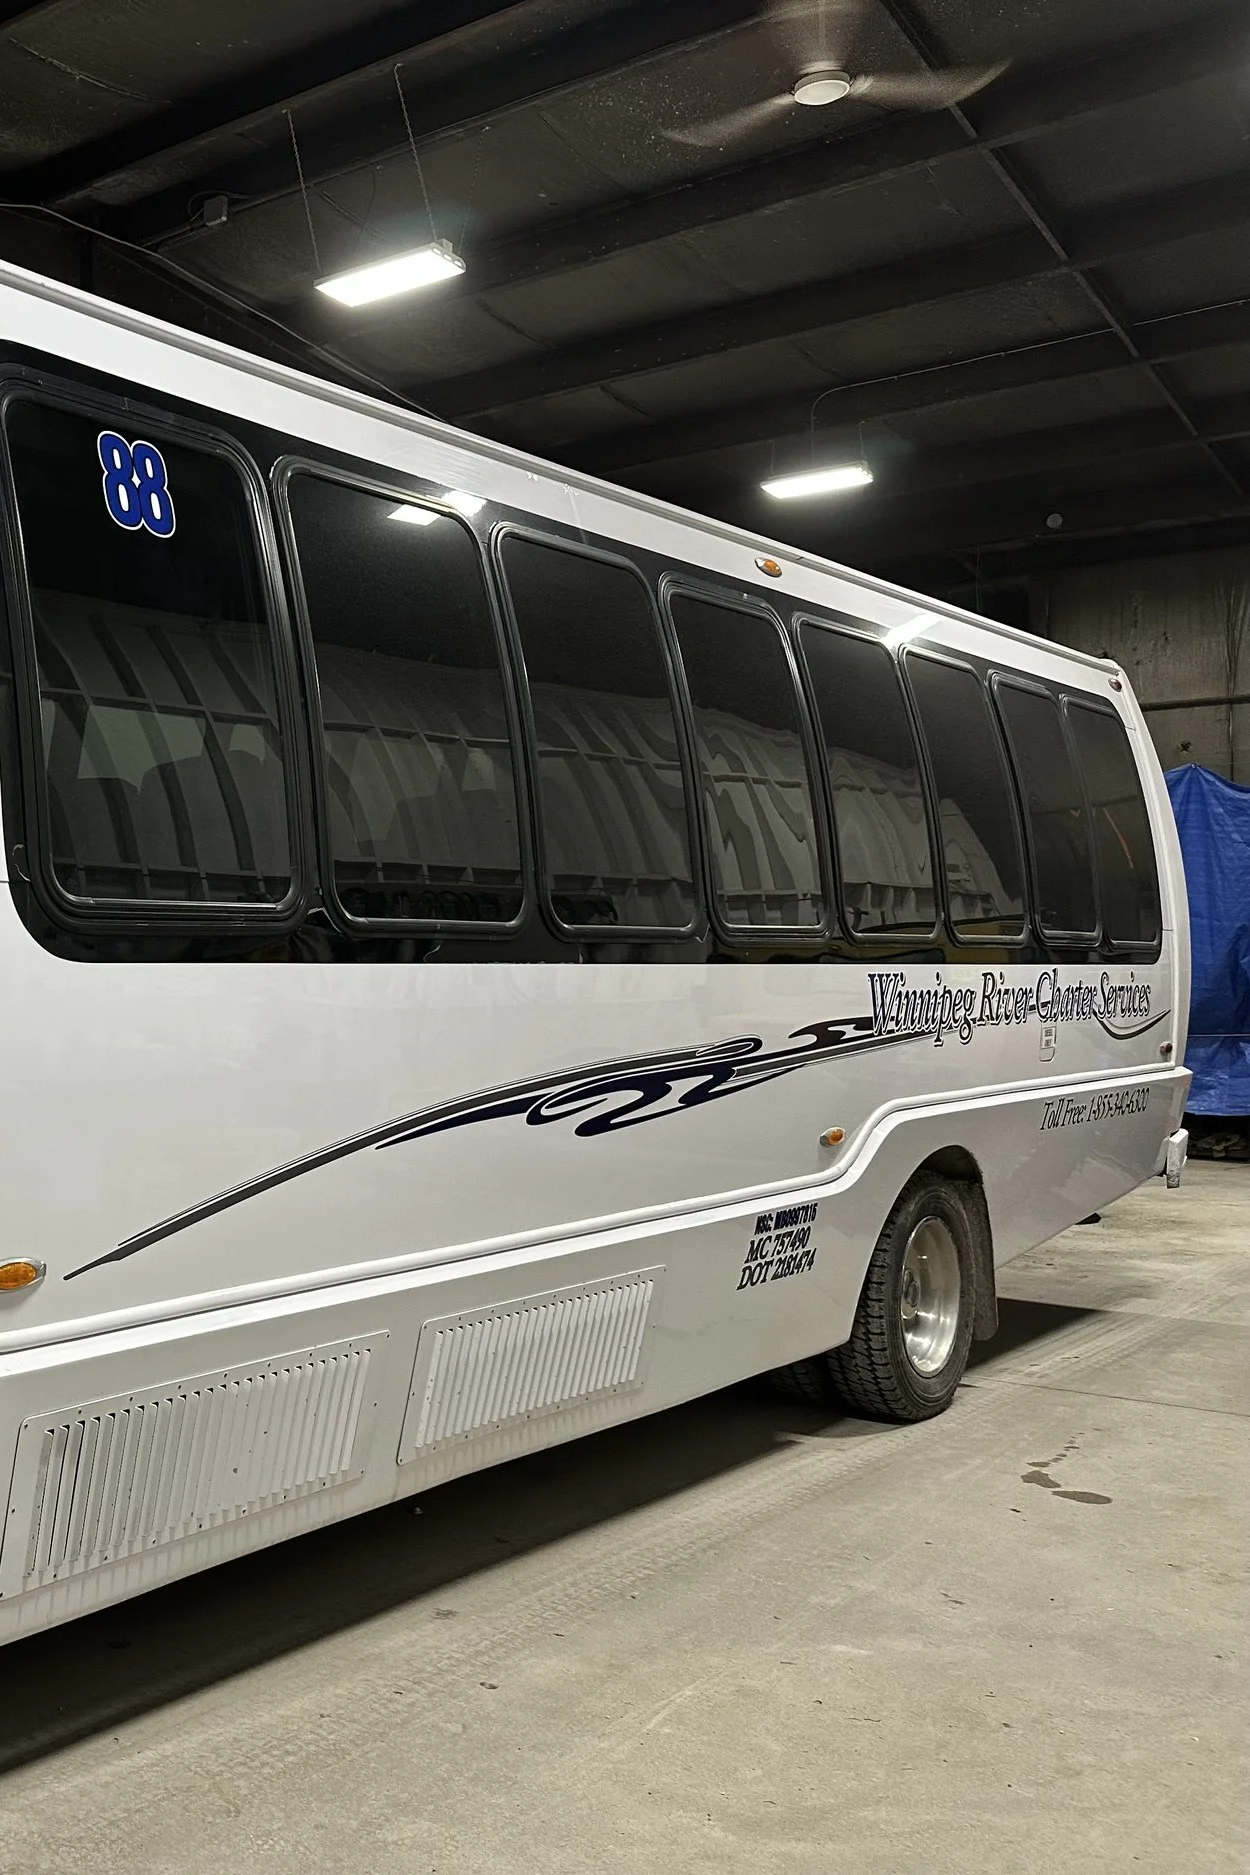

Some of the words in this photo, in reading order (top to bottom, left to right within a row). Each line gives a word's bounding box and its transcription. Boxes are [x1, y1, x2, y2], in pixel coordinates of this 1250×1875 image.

[97, 430, 176, 539] 88
[867, 971, 977, 1047] Winnipeg
[977, 971, 1035, 1026] River
[1035, 968, 1097, 1023] Charter
[1097, 971, 1151, 1019] Services
[1040, 1098, 1064, 1130] Toll
[1061, 1099, 1087, 1127] Free:
[744, 1235, 773, 1264] MC
[770, 1225, 811, 1258] 757490
[736, 1258, 775, 1291] DOT
[770, 1247, 817, 1281] 2181474
